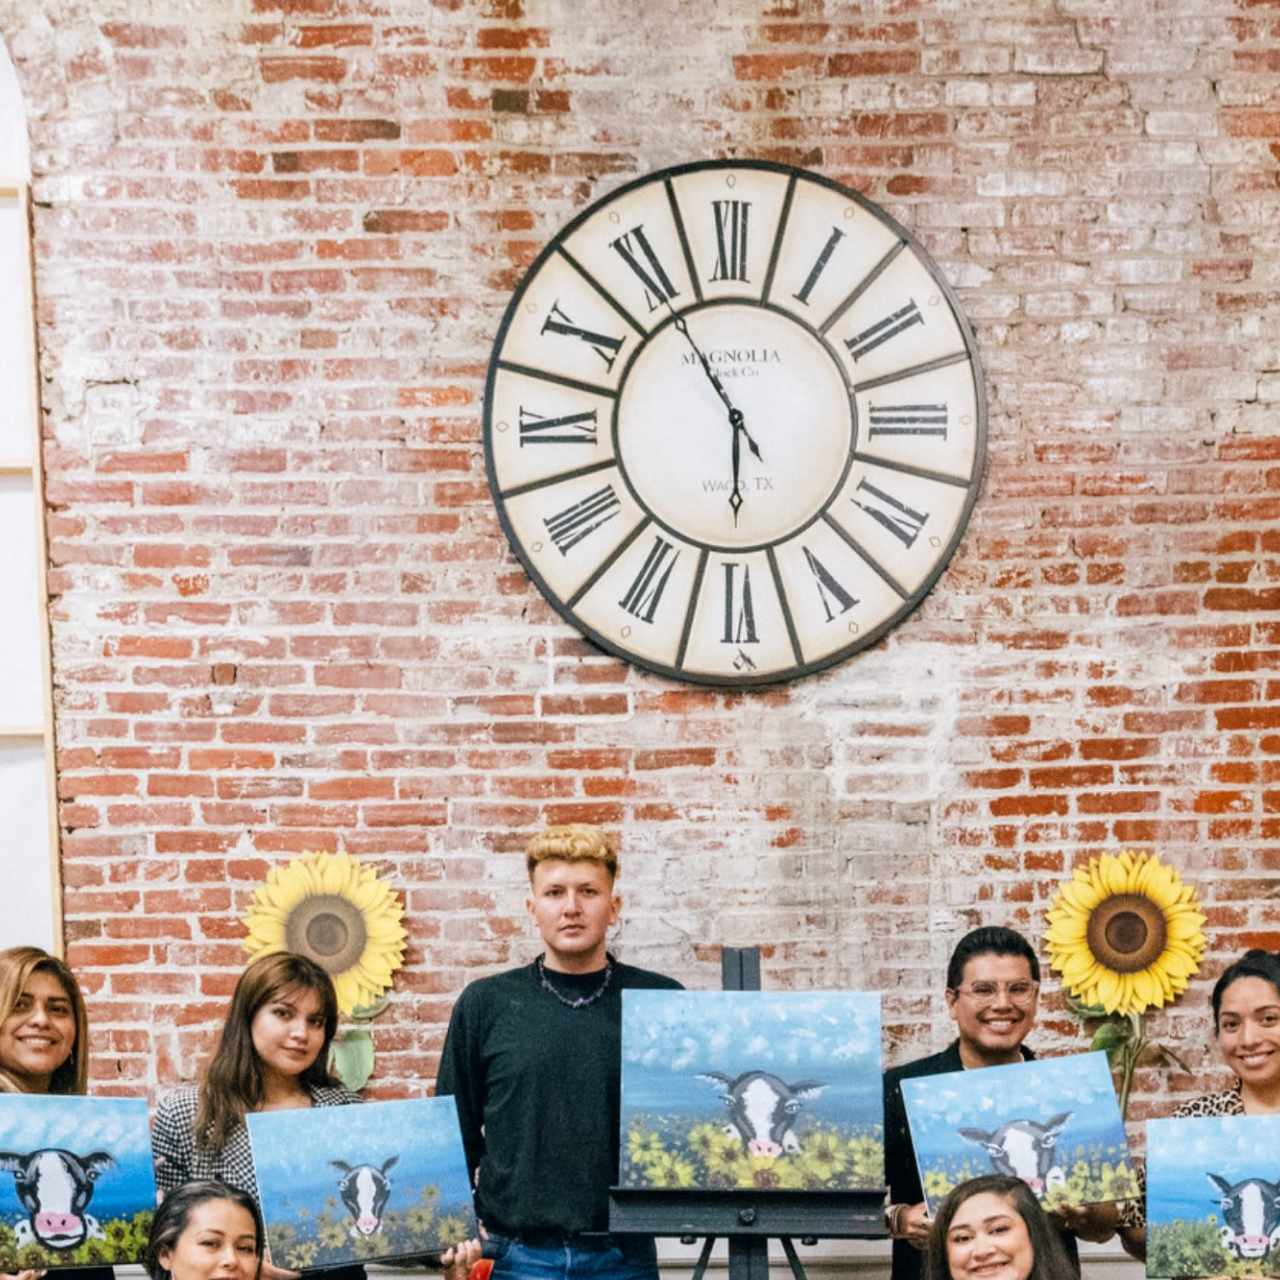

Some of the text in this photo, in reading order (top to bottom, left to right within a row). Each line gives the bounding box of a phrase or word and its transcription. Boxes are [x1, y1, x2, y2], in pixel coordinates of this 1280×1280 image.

[608, 224, 680, 313] XI
[709, 200, 752, 284] XII
[792, 226, 847, 306] I
[540, 298, 627, 374] X
[844, 298, 925, 364] II
[520, 406, 598, 448] IX
[868, 401, 948, 442] III
[543, 484, 621, 557] VIII
[752, 476, 775, 490] TX
[850, 476, 930, 549] IV
[618, 536, 681, 624] VII
[720, 563, 760, 643] VI
[801, 545, 861, 623] V
